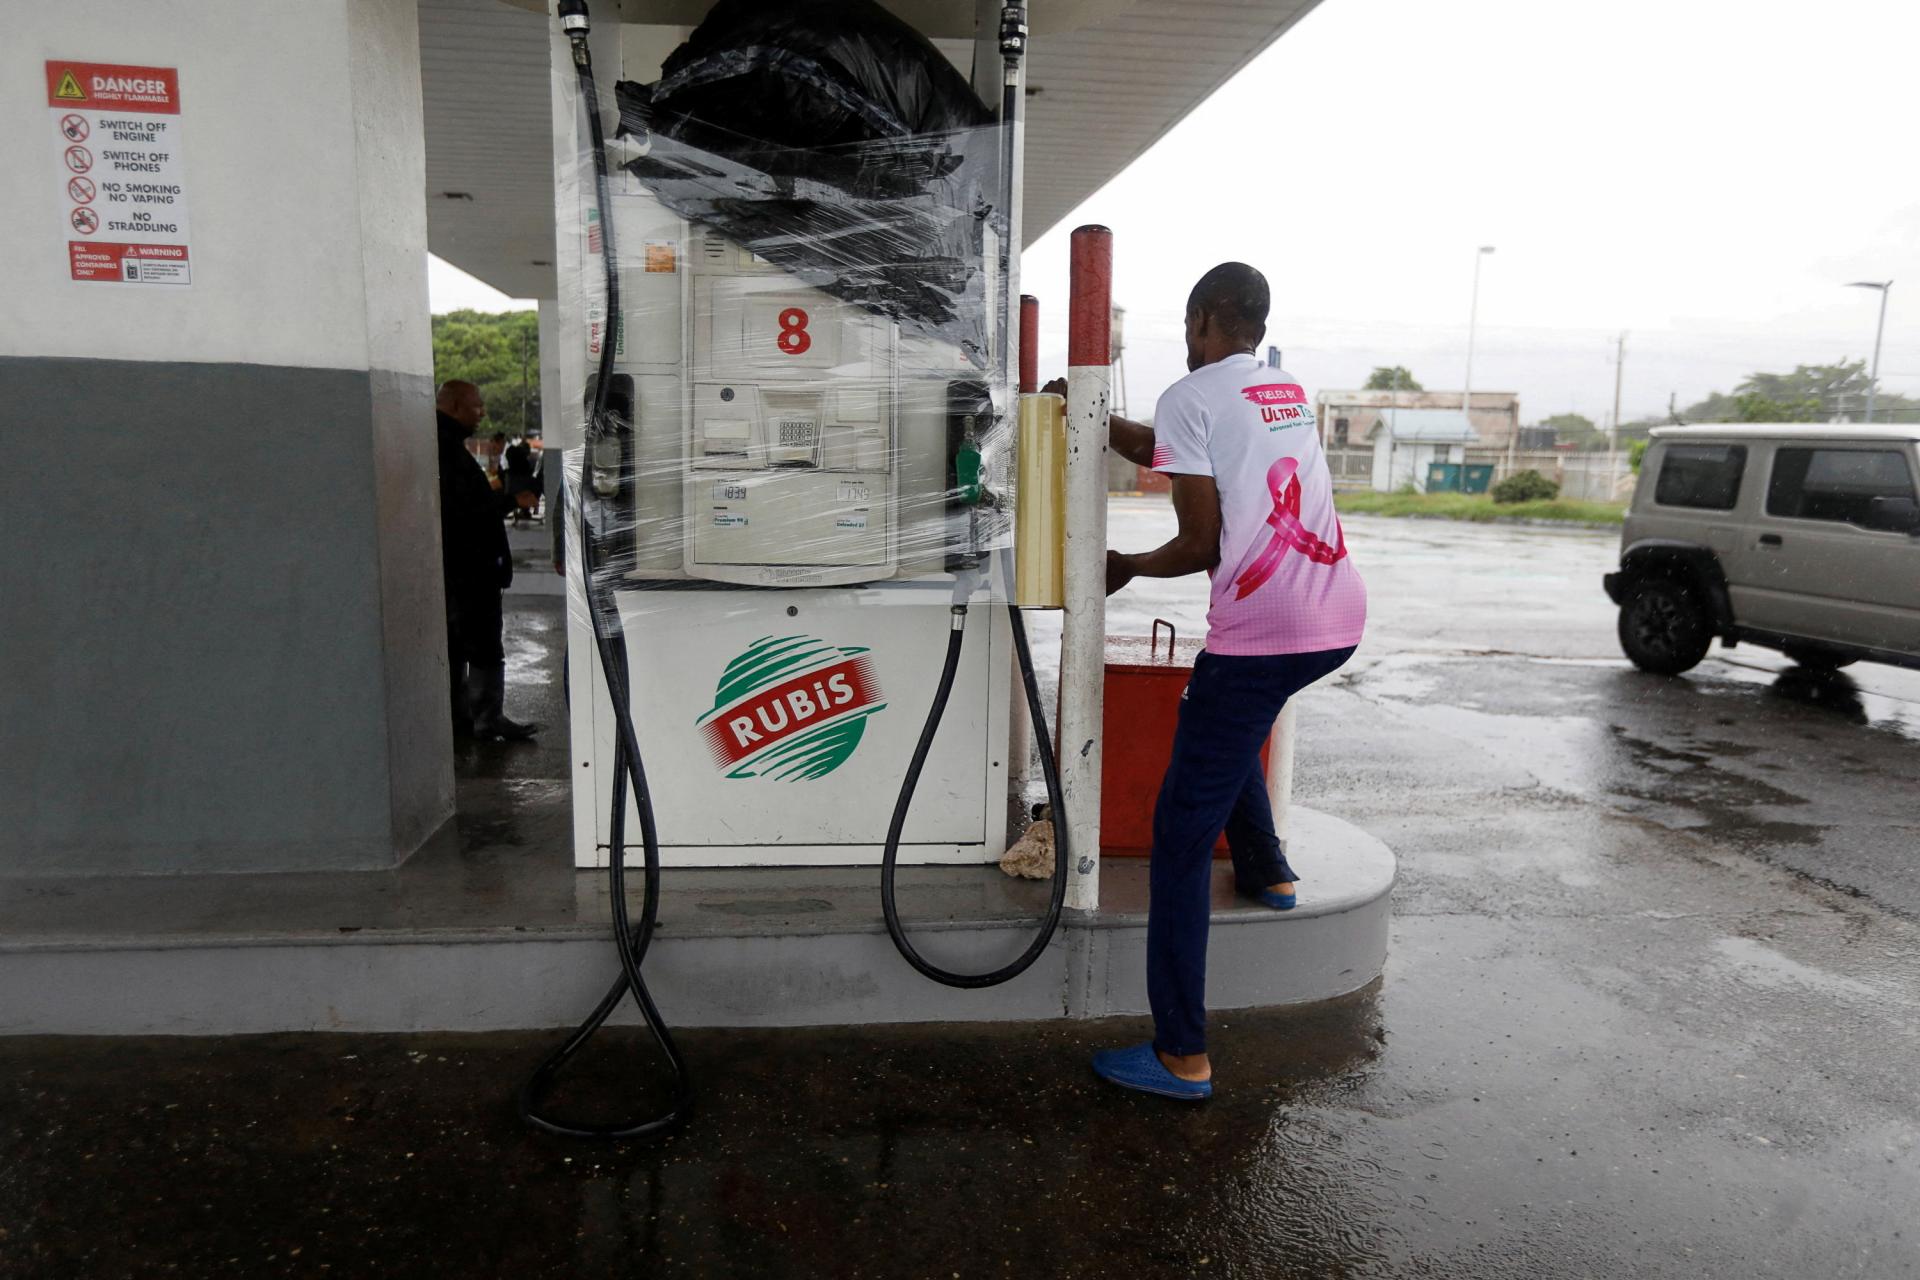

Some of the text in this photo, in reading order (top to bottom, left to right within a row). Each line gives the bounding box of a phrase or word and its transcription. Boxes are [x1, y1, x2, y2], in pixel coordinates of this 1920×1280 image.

[92, 76, 167, 94] DANGER
[94, 92, 170, 103] HIGHLY FLAMMABLE
[99, 119, 167, 132] SWITCH OFF
[113, 131, 156, 142] ENGINE
[102, 150, 170, 162] SWITCH OFF
[114, 162, 161, 173] PHONES
[102, 182, 181, 195] NO SMOKING
[109, 193, 175, 204] NO VAPING
[132, 212, 152, 222] NO
[108, 221, 178, 233] STRADDLING
[139, 247, 183, 257] WARNING
[777, 307, 812, 355] 8
[1256, 390, 1297, 401] FUELED BY
[1261, 404, 1315, 423] ULTRAT
